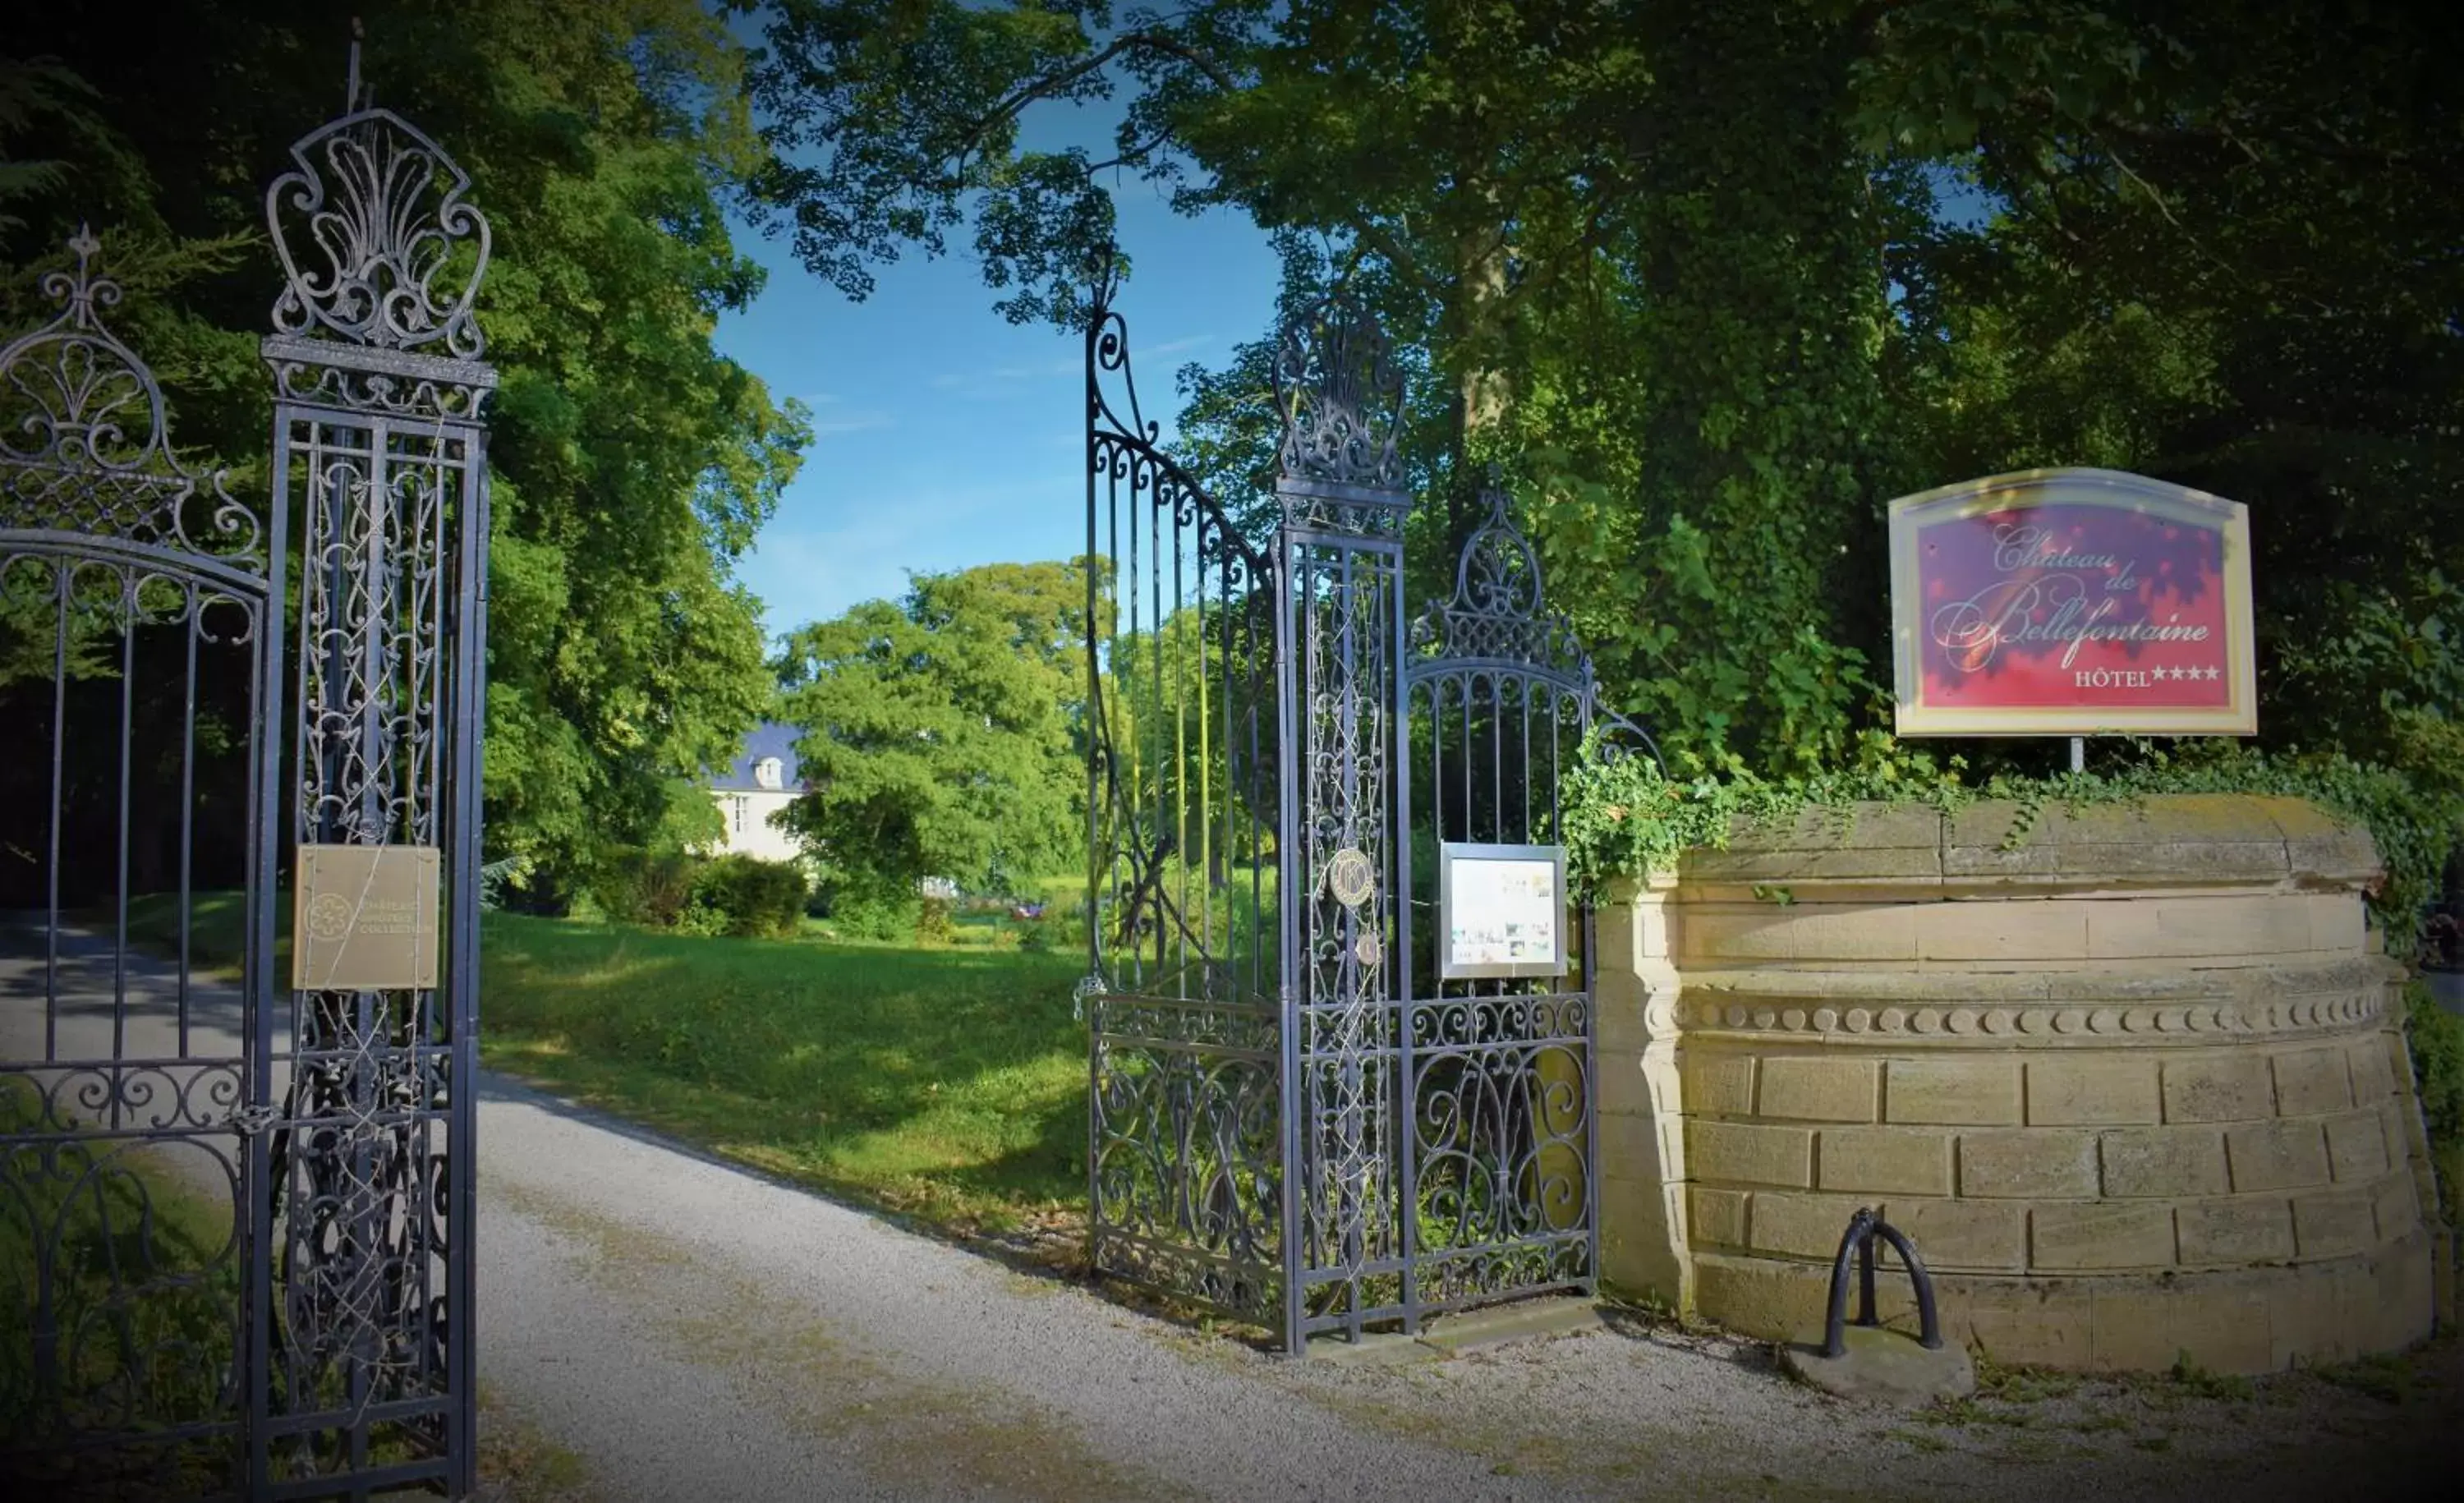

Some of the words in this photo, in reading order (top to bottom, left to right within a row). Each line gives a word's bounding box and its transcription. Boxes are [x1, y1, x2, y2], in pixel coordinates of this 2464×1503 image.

[2104, 559, 2139, 591] de
[1931, 572, 2209, 672] Bellefontaine
[2075, 665, 2151, 687] HÔTEL
